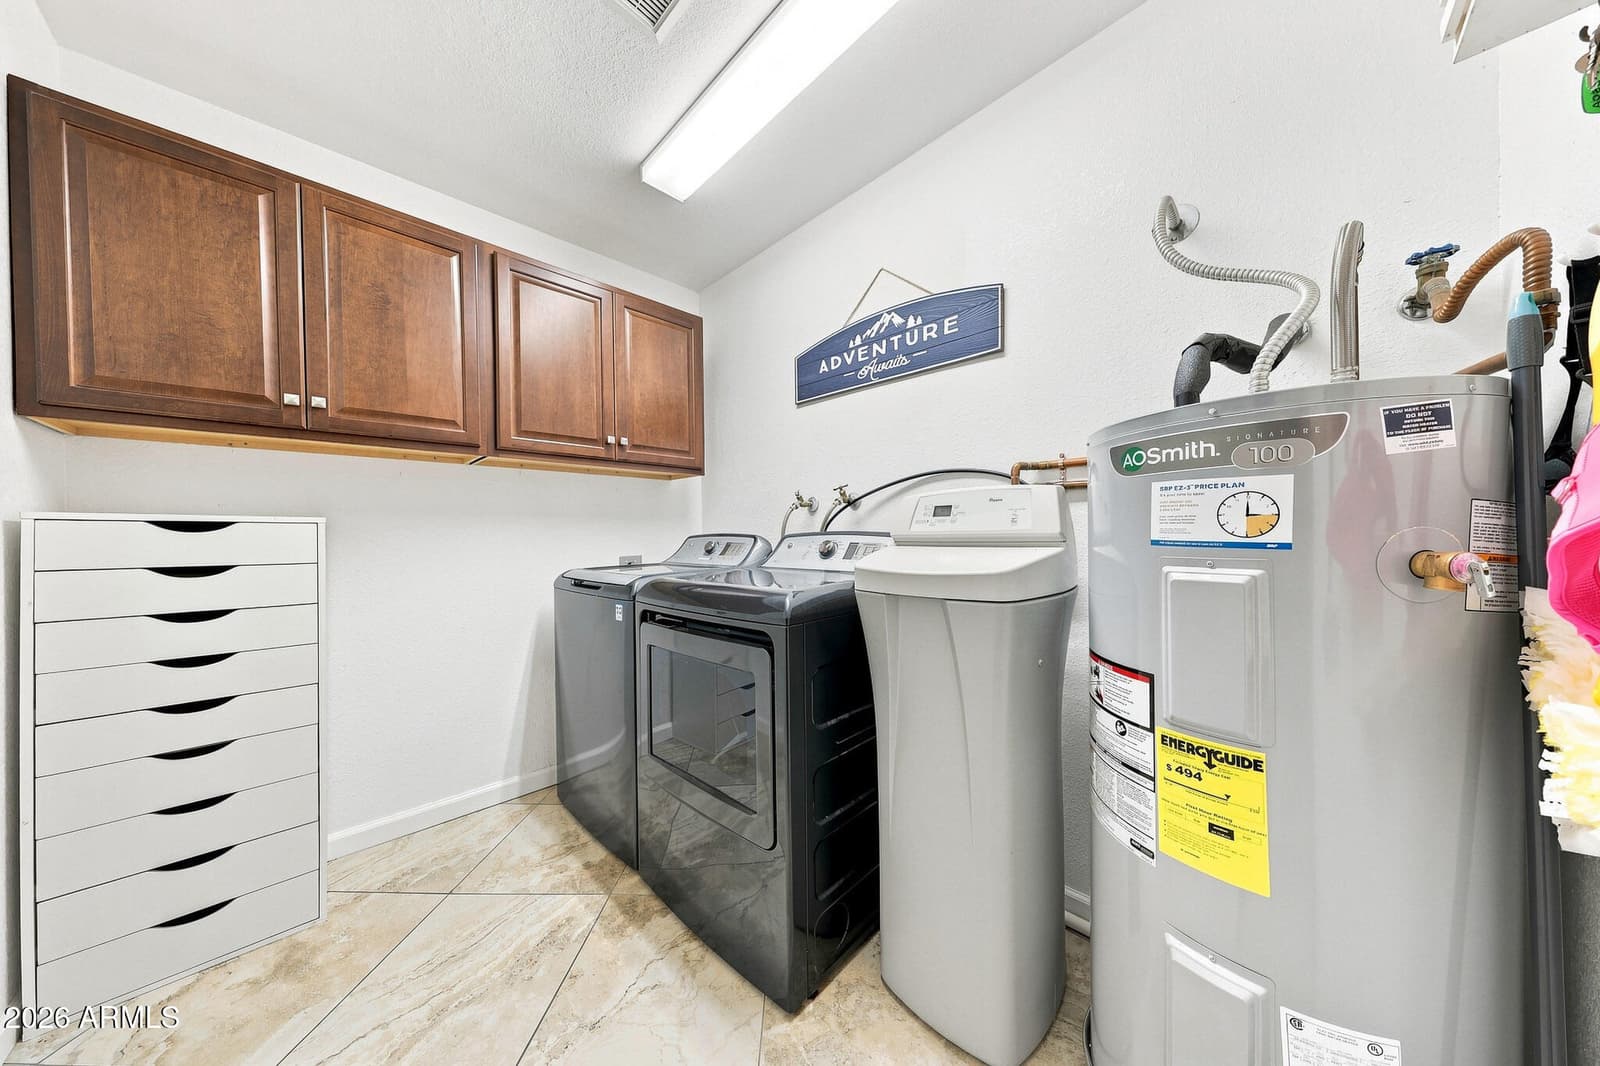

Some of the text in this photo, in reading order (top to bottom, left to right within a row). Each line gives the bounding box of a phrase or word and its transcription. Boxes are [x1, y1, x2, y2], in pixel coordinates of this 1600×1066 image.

[819, 314, 959, 374] ADVENTURE
[857, 354, 911, 381] Awaits
[1226, 426, 1321, 442] SIGNATURE
[1248, 444, 1295, 465] 100
[1220, 481, 1245, 489] PLAN
[1161, 734, 1264, 773] ENERGYGUIDE
[1175, 766, 1202, 782] 494
